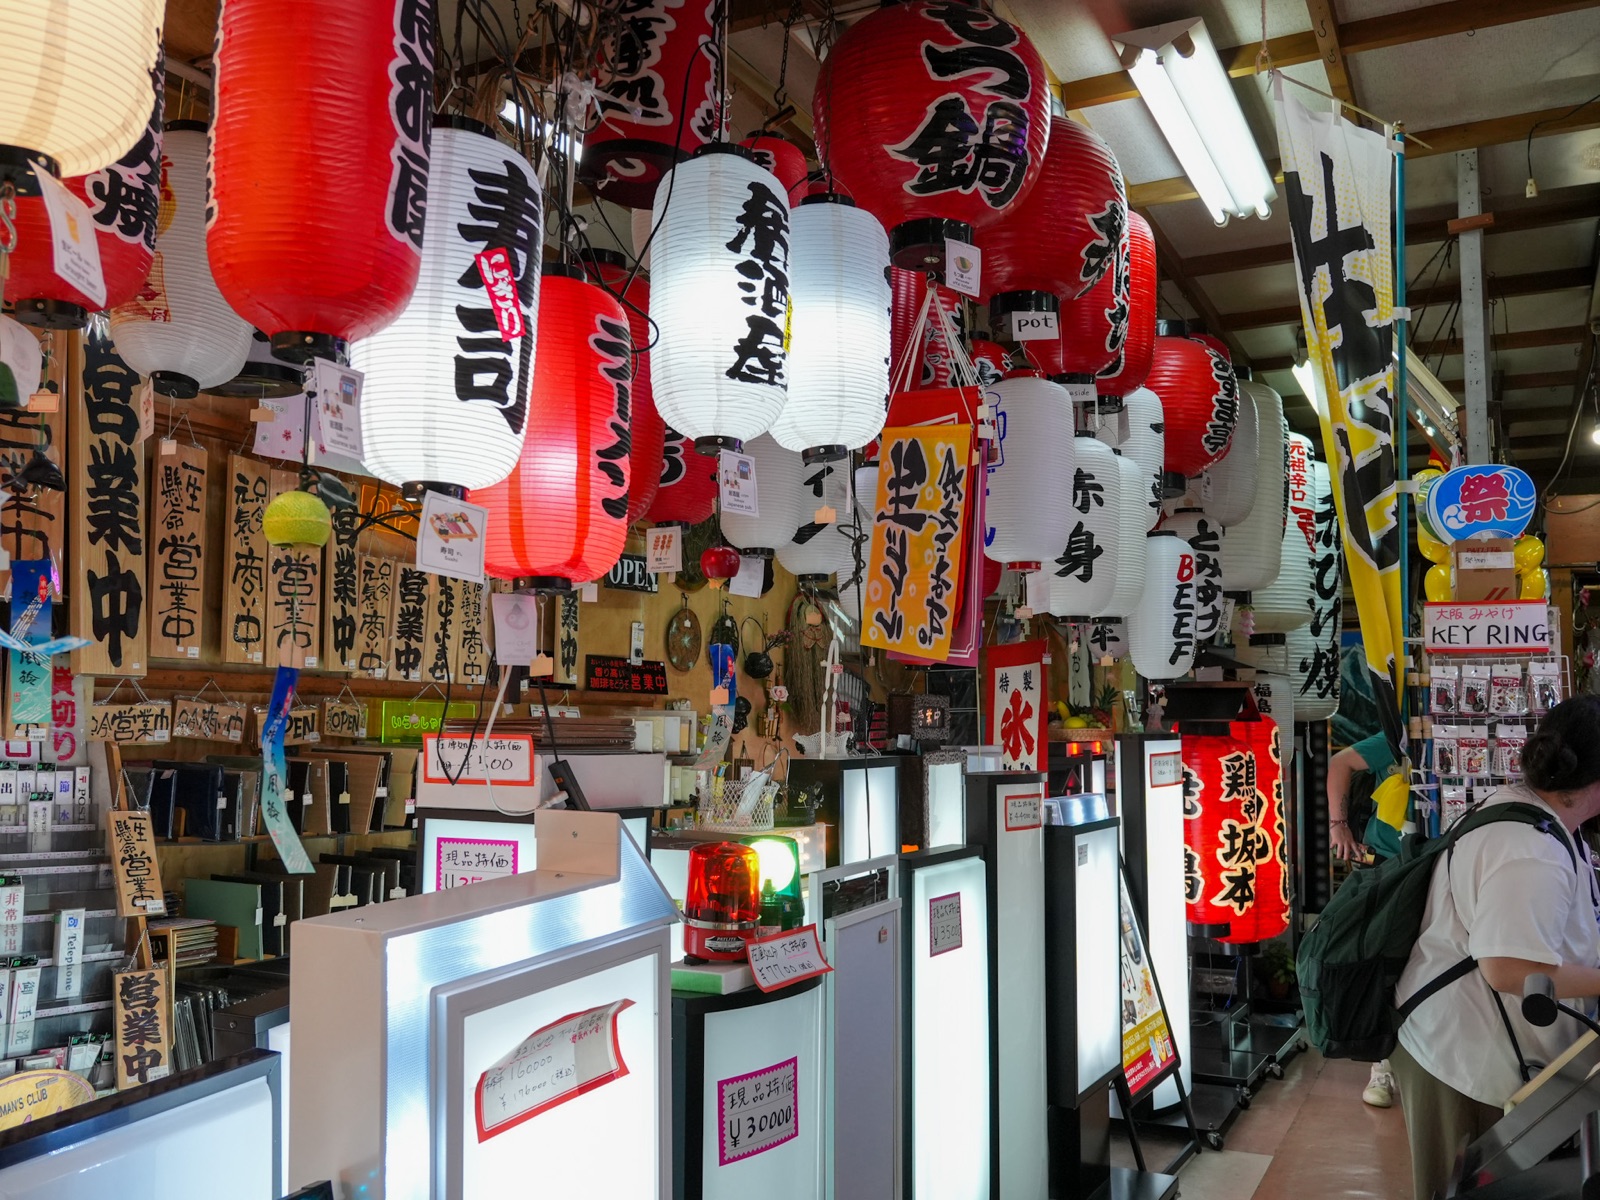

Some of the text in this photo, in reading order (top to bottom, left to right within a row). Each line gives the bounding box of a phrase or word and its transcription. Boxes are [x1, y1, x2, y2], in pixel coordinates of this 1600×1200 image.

[158, 532, 202, 645] 営業中
[395, 567, 429, 680] 営業中
[1169, 554, 1194, 665] BEEF
[1432, 623, 1549, 645] KEY RING
[64, 933, 78, 992] Telephone
[120, 972, 164, 1084] 営業中
